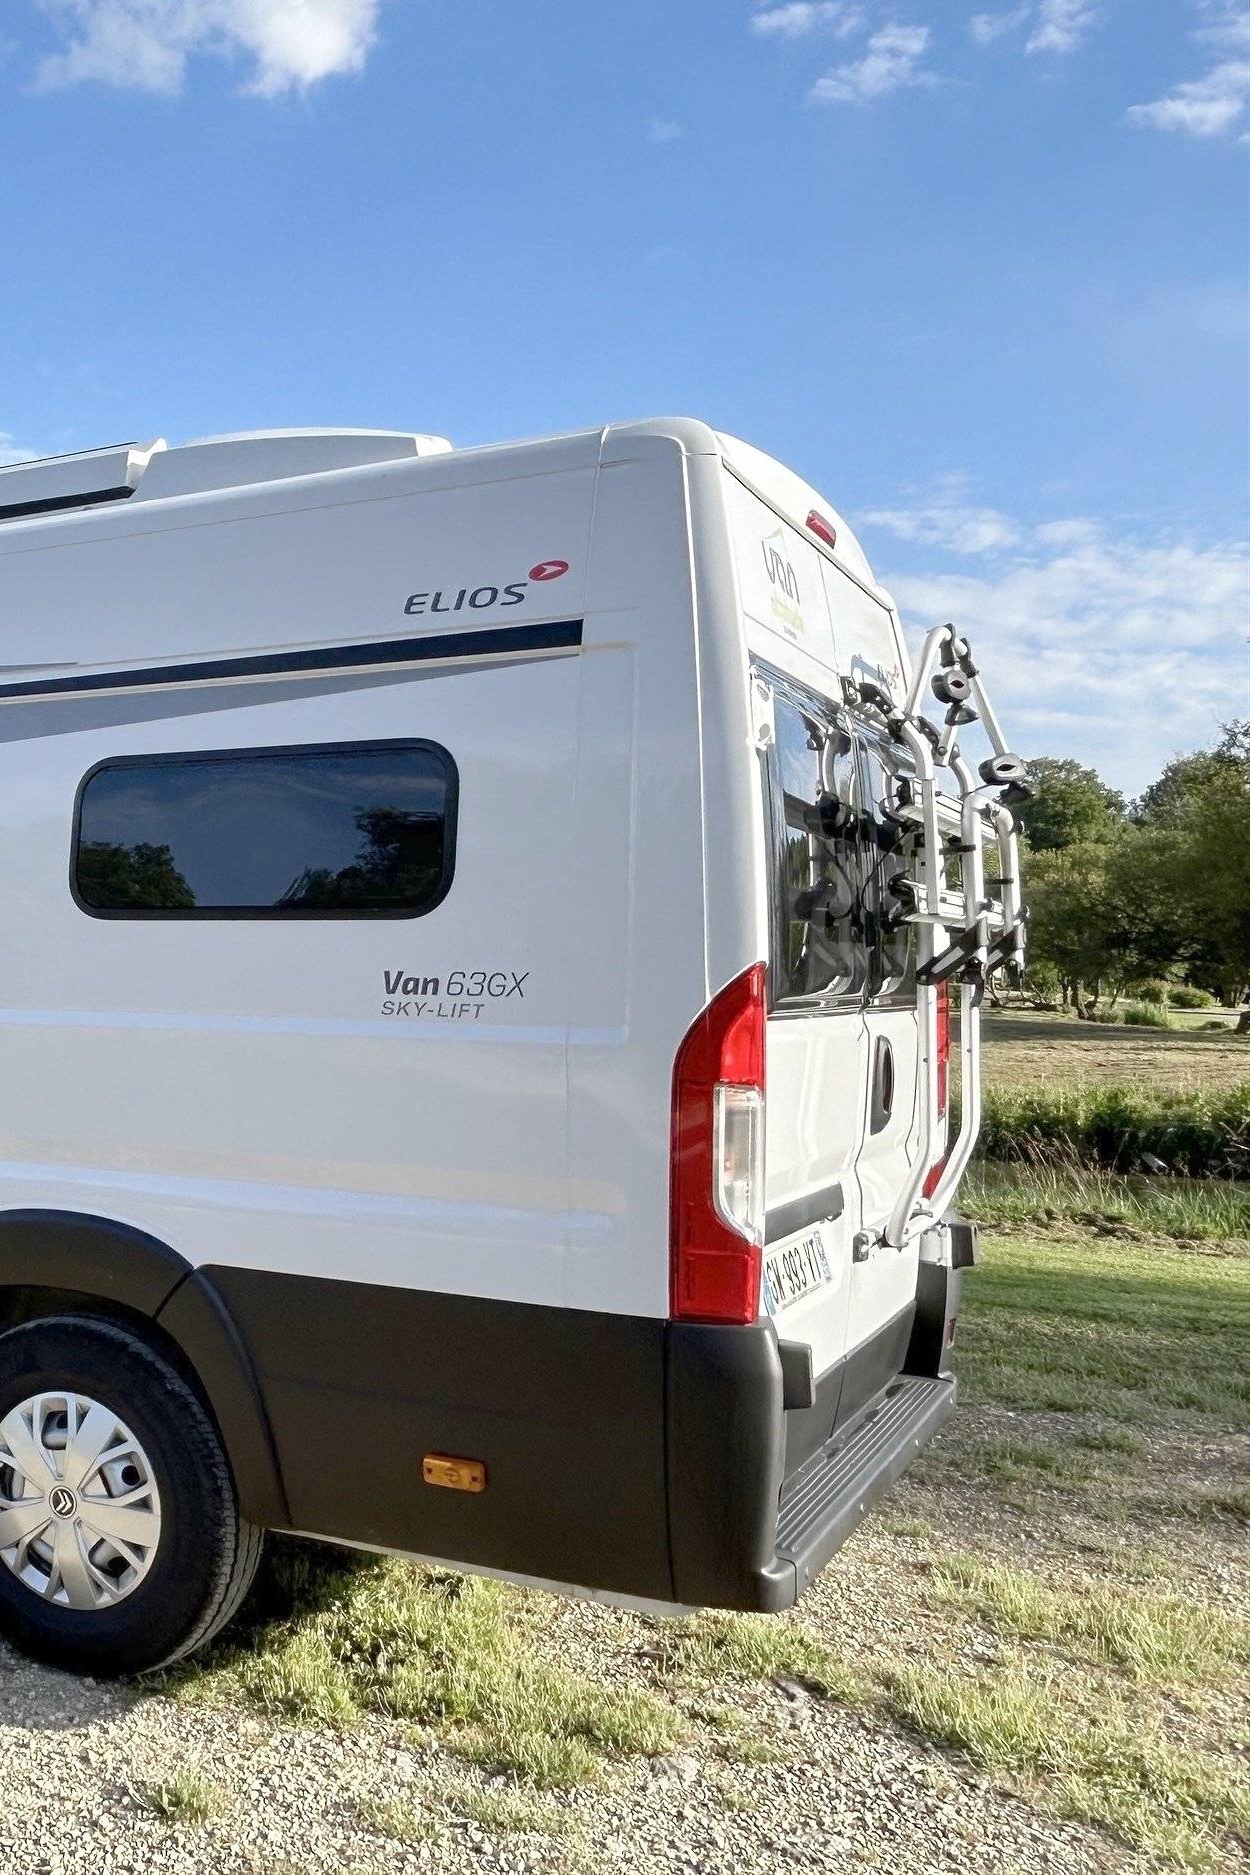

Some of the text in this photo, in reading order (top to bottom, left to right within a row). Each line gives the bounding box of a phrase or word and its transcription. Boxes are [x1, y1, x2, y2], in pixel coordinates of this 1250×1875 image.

[403, 582, 528, 615] ELIOS
[383, 970, 529, 998] Van 63GX
[381, 1000, 485, 1019] SKY-LIFT
